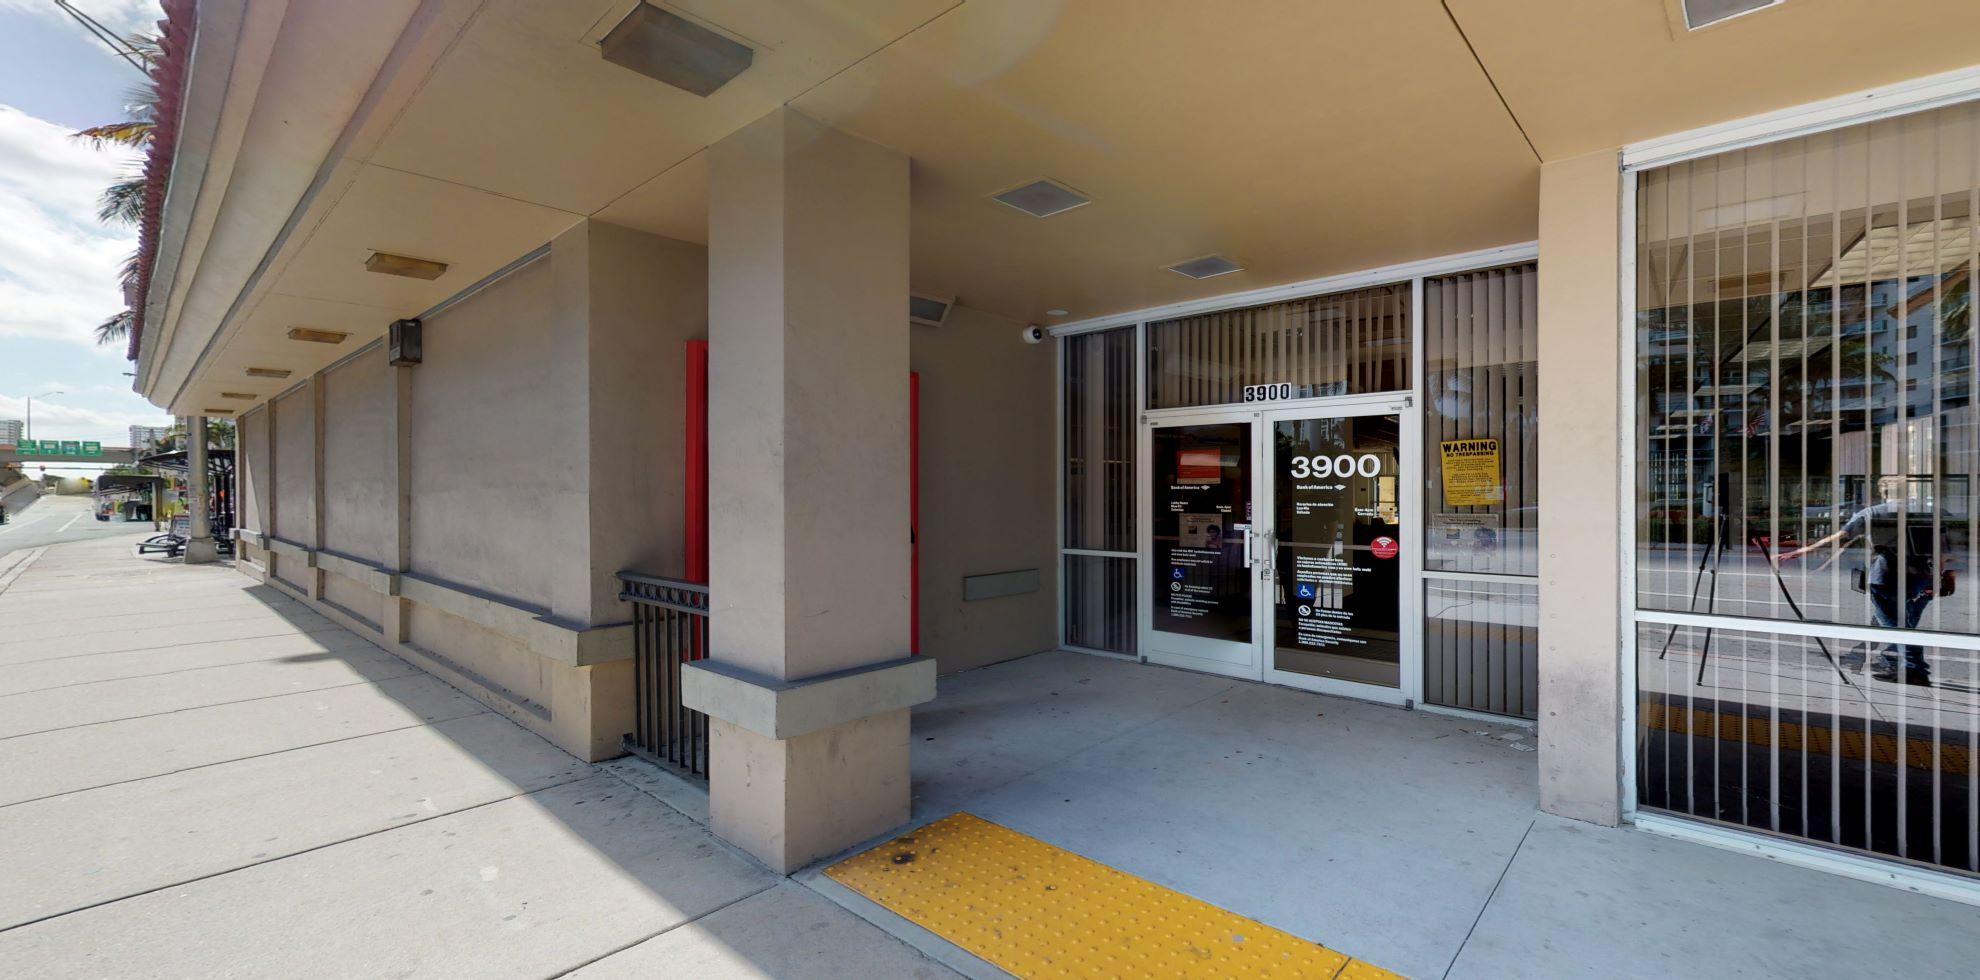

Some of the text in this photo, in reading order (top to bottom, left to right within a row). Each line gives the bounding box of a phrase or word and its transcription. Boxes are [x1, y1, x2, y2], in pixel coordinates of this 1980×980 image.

[1246, 384, 1289, 401] 3900
[1442, 442, 1497, 453] WARNING
[1291, 454, 1381, 478] 3900
